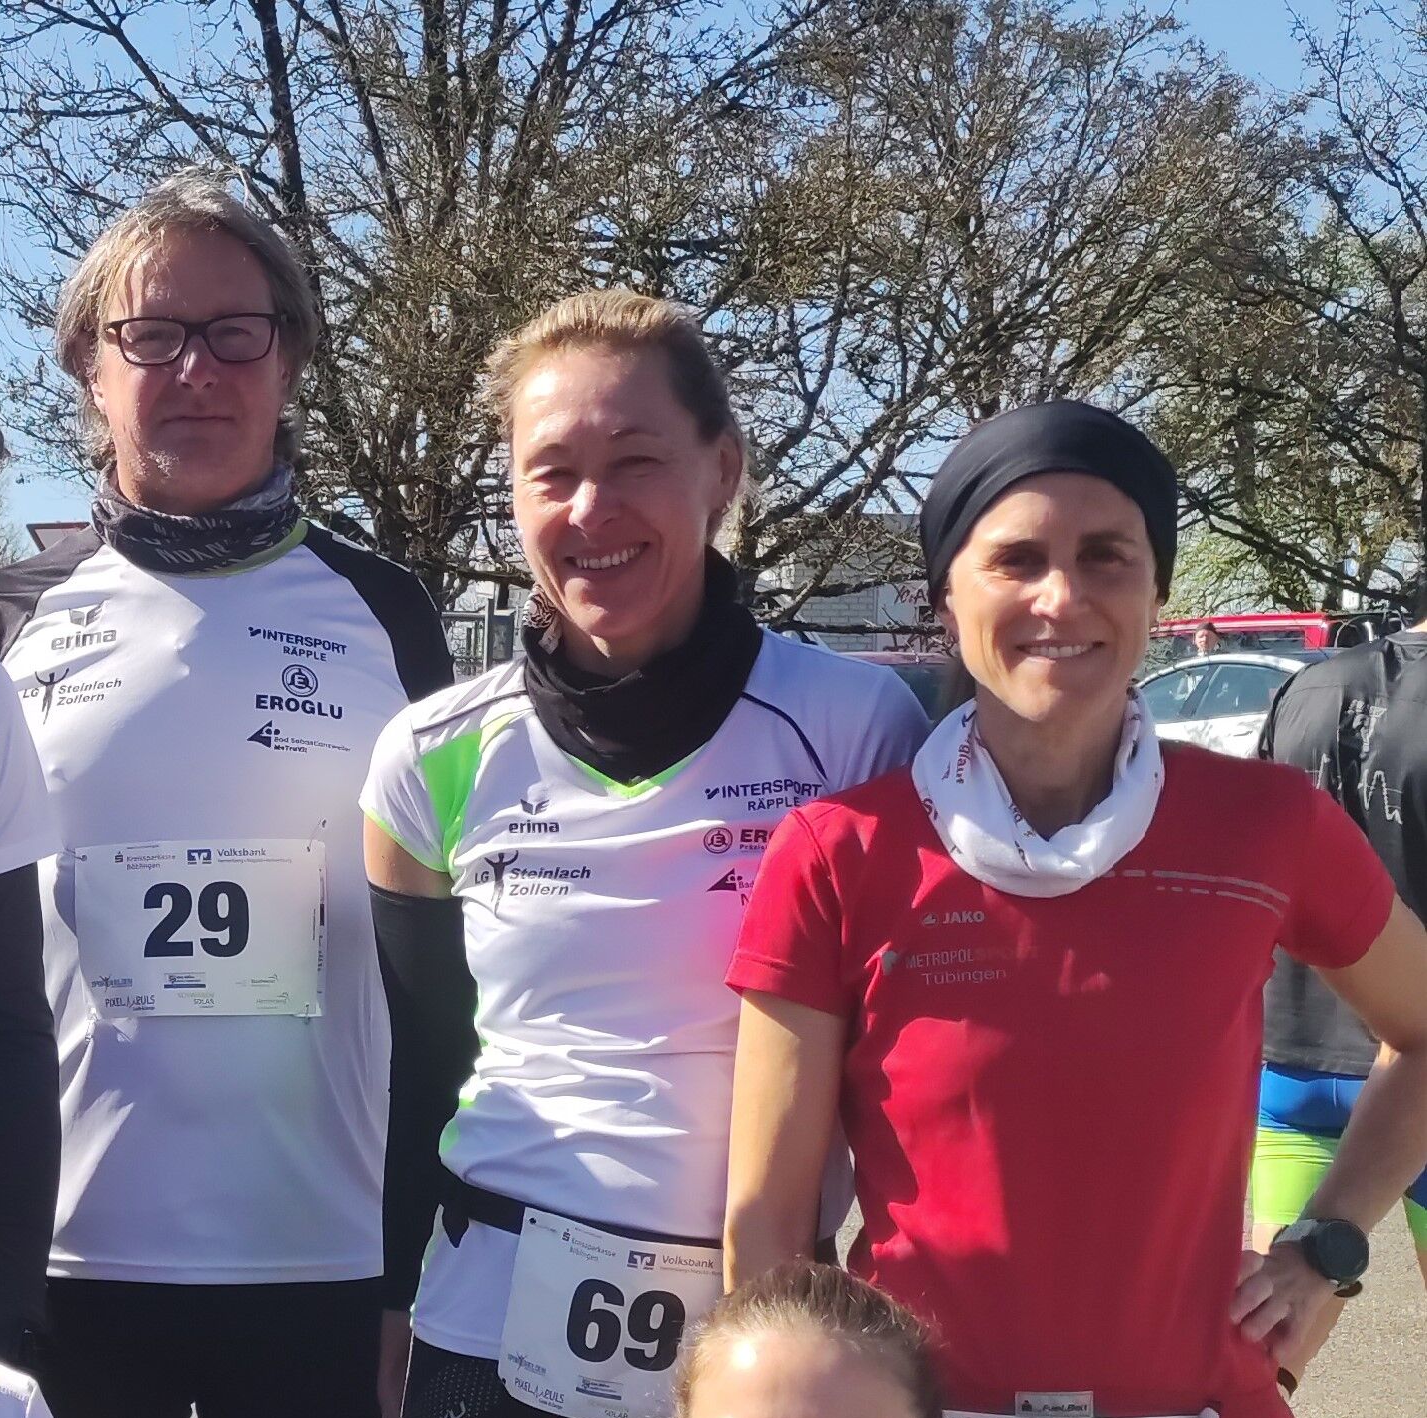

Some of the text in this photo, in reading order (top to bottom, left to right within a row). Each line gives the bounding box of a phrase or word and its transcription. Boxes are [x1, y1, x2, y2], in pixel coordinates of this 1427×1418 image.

[51, 629, 117, 650] erima
[263, 629, 347, 655] INTERSPORT
[283, 645, 327, 662] RÄPPLE
[23, 678, 122, 699] LG Steinlach
[57, 694, 105, 706] Zollern
[256, 694, 343, 720] EROGLU
[722, 779, 822, 798] INTERSPORT
[748, 797, 801, 811] RÄPPLE
[509, 820, 560, 833] erima
[217, 848, 266, 857] Volksbank
[475, 866, 591, 884] LG Steinlach
[509, 884, 569, 896] Zollern
[143, 881, 250, 958] 29
[943, 911, 985, 924] JAKO
[662, 1254, 714, 1269] Volksbank
[567, 1279, 686, 1371] 69
